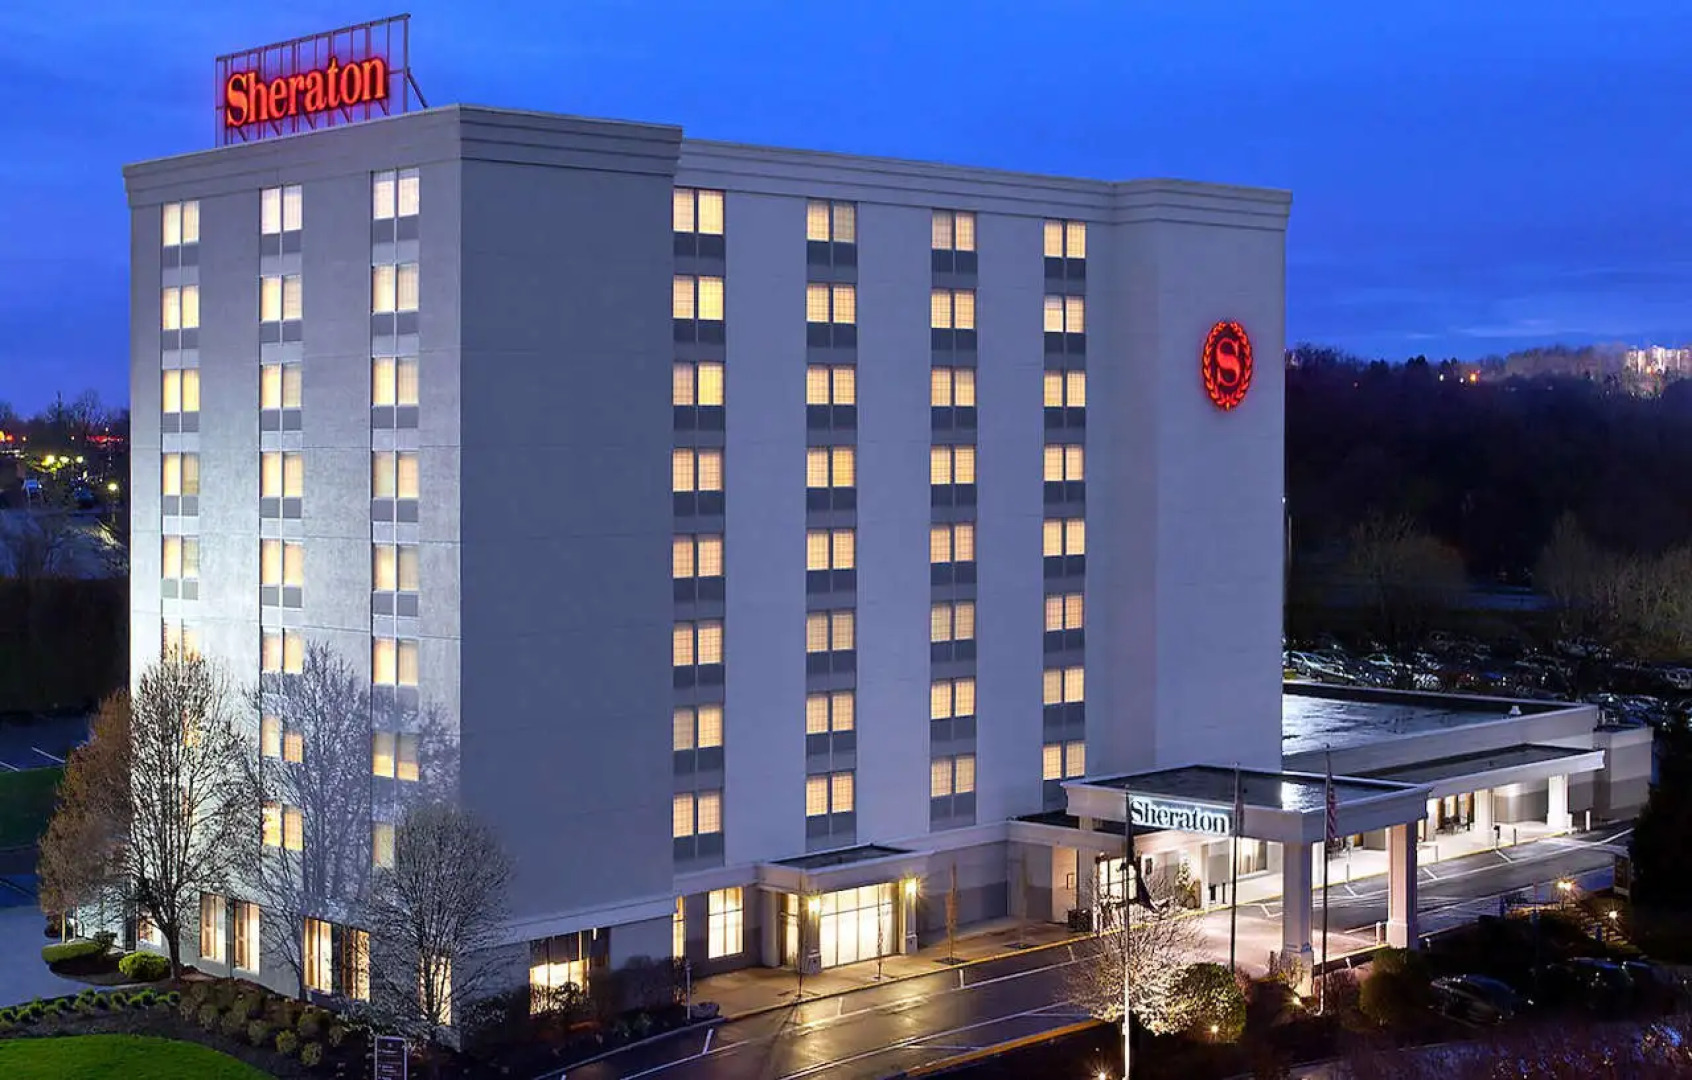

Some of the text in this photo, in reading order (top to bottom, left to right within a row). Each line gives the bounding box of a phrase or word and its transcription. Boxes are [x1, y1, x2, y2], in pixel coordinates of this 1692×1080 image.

[225, 57, 387, 127] Sheraton
[1216, 337, 1240, 387] S
[1129, 798, 1228, 834] Sheraton
